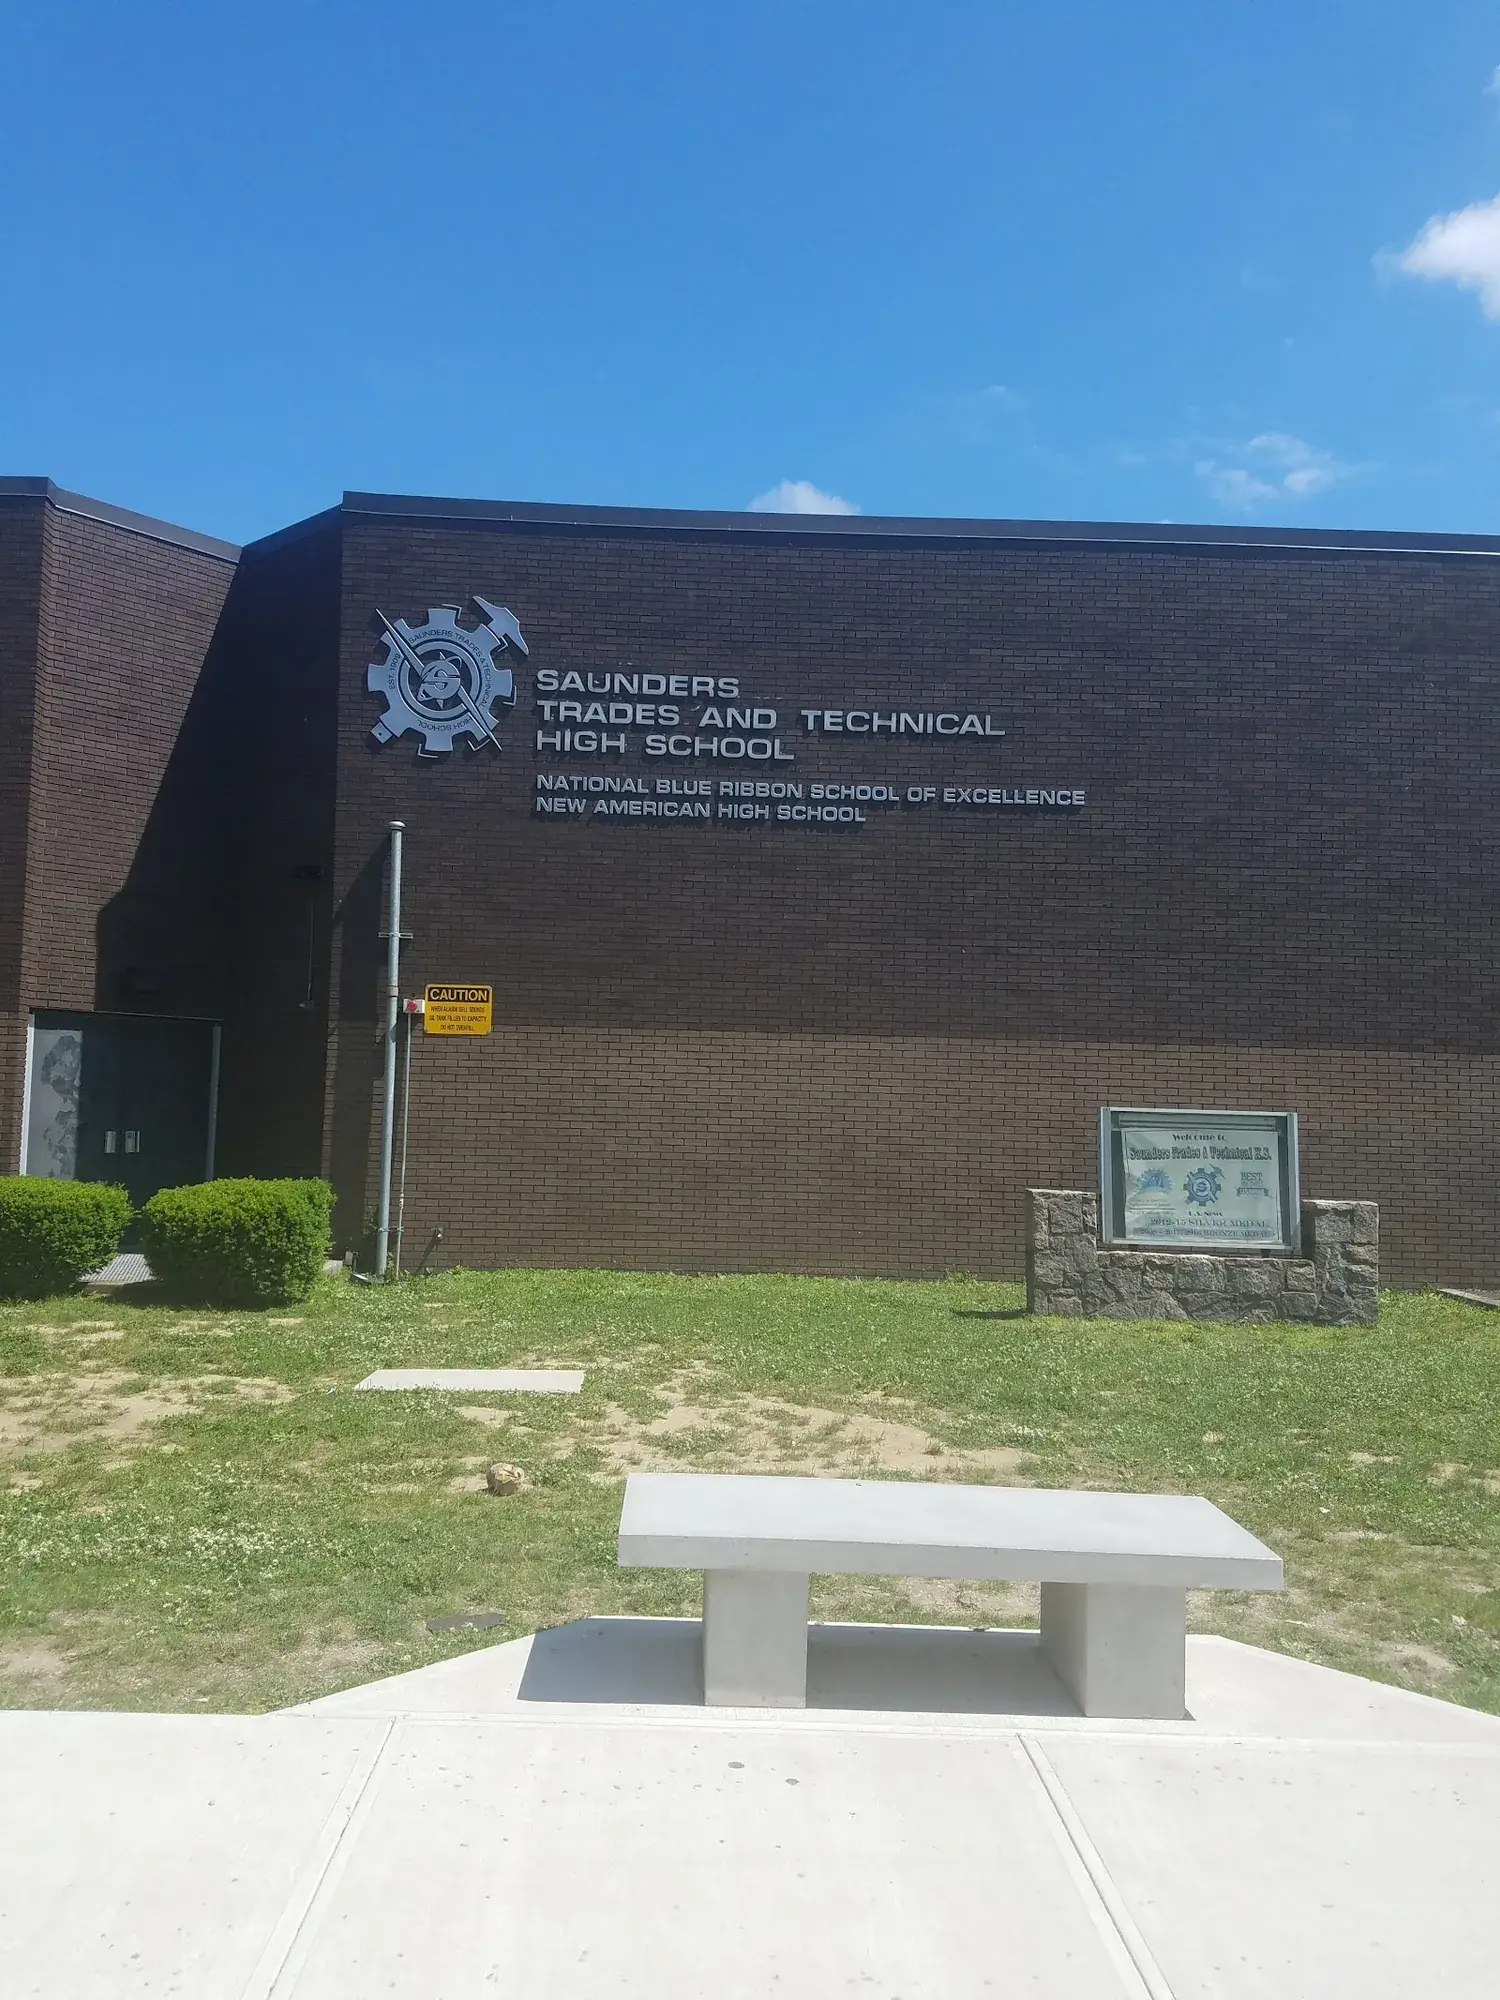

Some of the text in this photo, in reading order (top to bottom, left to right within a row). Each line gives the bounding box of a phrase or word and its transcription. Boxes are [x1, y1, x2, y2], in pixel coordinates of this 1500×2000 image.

[388, 653, 401, 690] EST. 1909
[408, 629, 453, 644] SAUNDERS
[455, 632, 483, 658] TRADES
[478, 663, 492, 707] TECHNICAL
[536, 669, 740, 698] SAUNDERS
[417, 715, 473, 732] HIGH SCHOOL
[536, 700, 1006, 736] TRADES AND TECHNICAL
[536, 729, 795, 760] HIGH SCHOOL
[536, 774, 1086, 806] NATIONAL BLUE RIBBON SCHOOL OF EXCELLENCE
[536, 796, 866, 822] NEW AMERICAN HIGH SCHOOL
[430, 989, 488, 1001] CAUTION
[1130, 1147, 1170, 1160] Saunders
[1172, 1146, 1200, 1160] Trades
[1210, 1146, 1252, 1160] Technical
[1254, 1147, 1272, 1160] H.S.
[1240, 1172, 1263, 1181] BEST
[1188, 1219, 1227, 1227] SILVER
[1230, 1220, 1266, 1228] MEDAL
